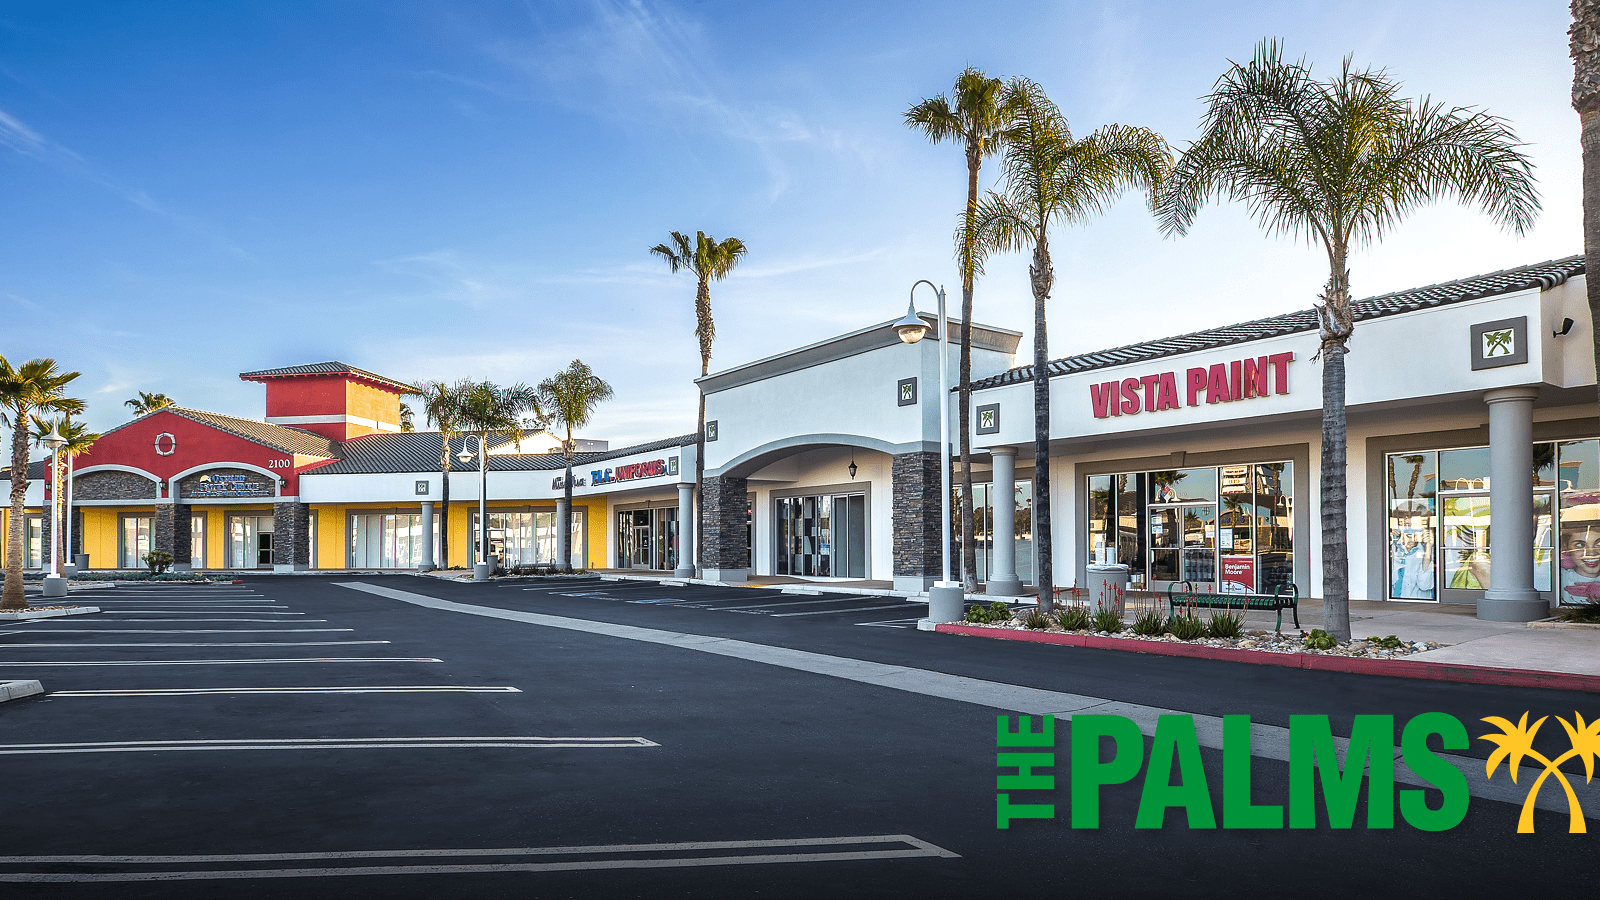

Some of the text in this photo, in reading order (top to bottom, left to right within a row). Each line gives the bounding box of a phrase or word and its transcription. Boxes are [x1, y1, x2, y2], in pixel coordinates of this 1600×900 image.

[1090, 351, 1294, 418] VISTA PAINT
[268, 458, 290, 469] 2100
[615, 459, 663, 480] UNIFORMS
